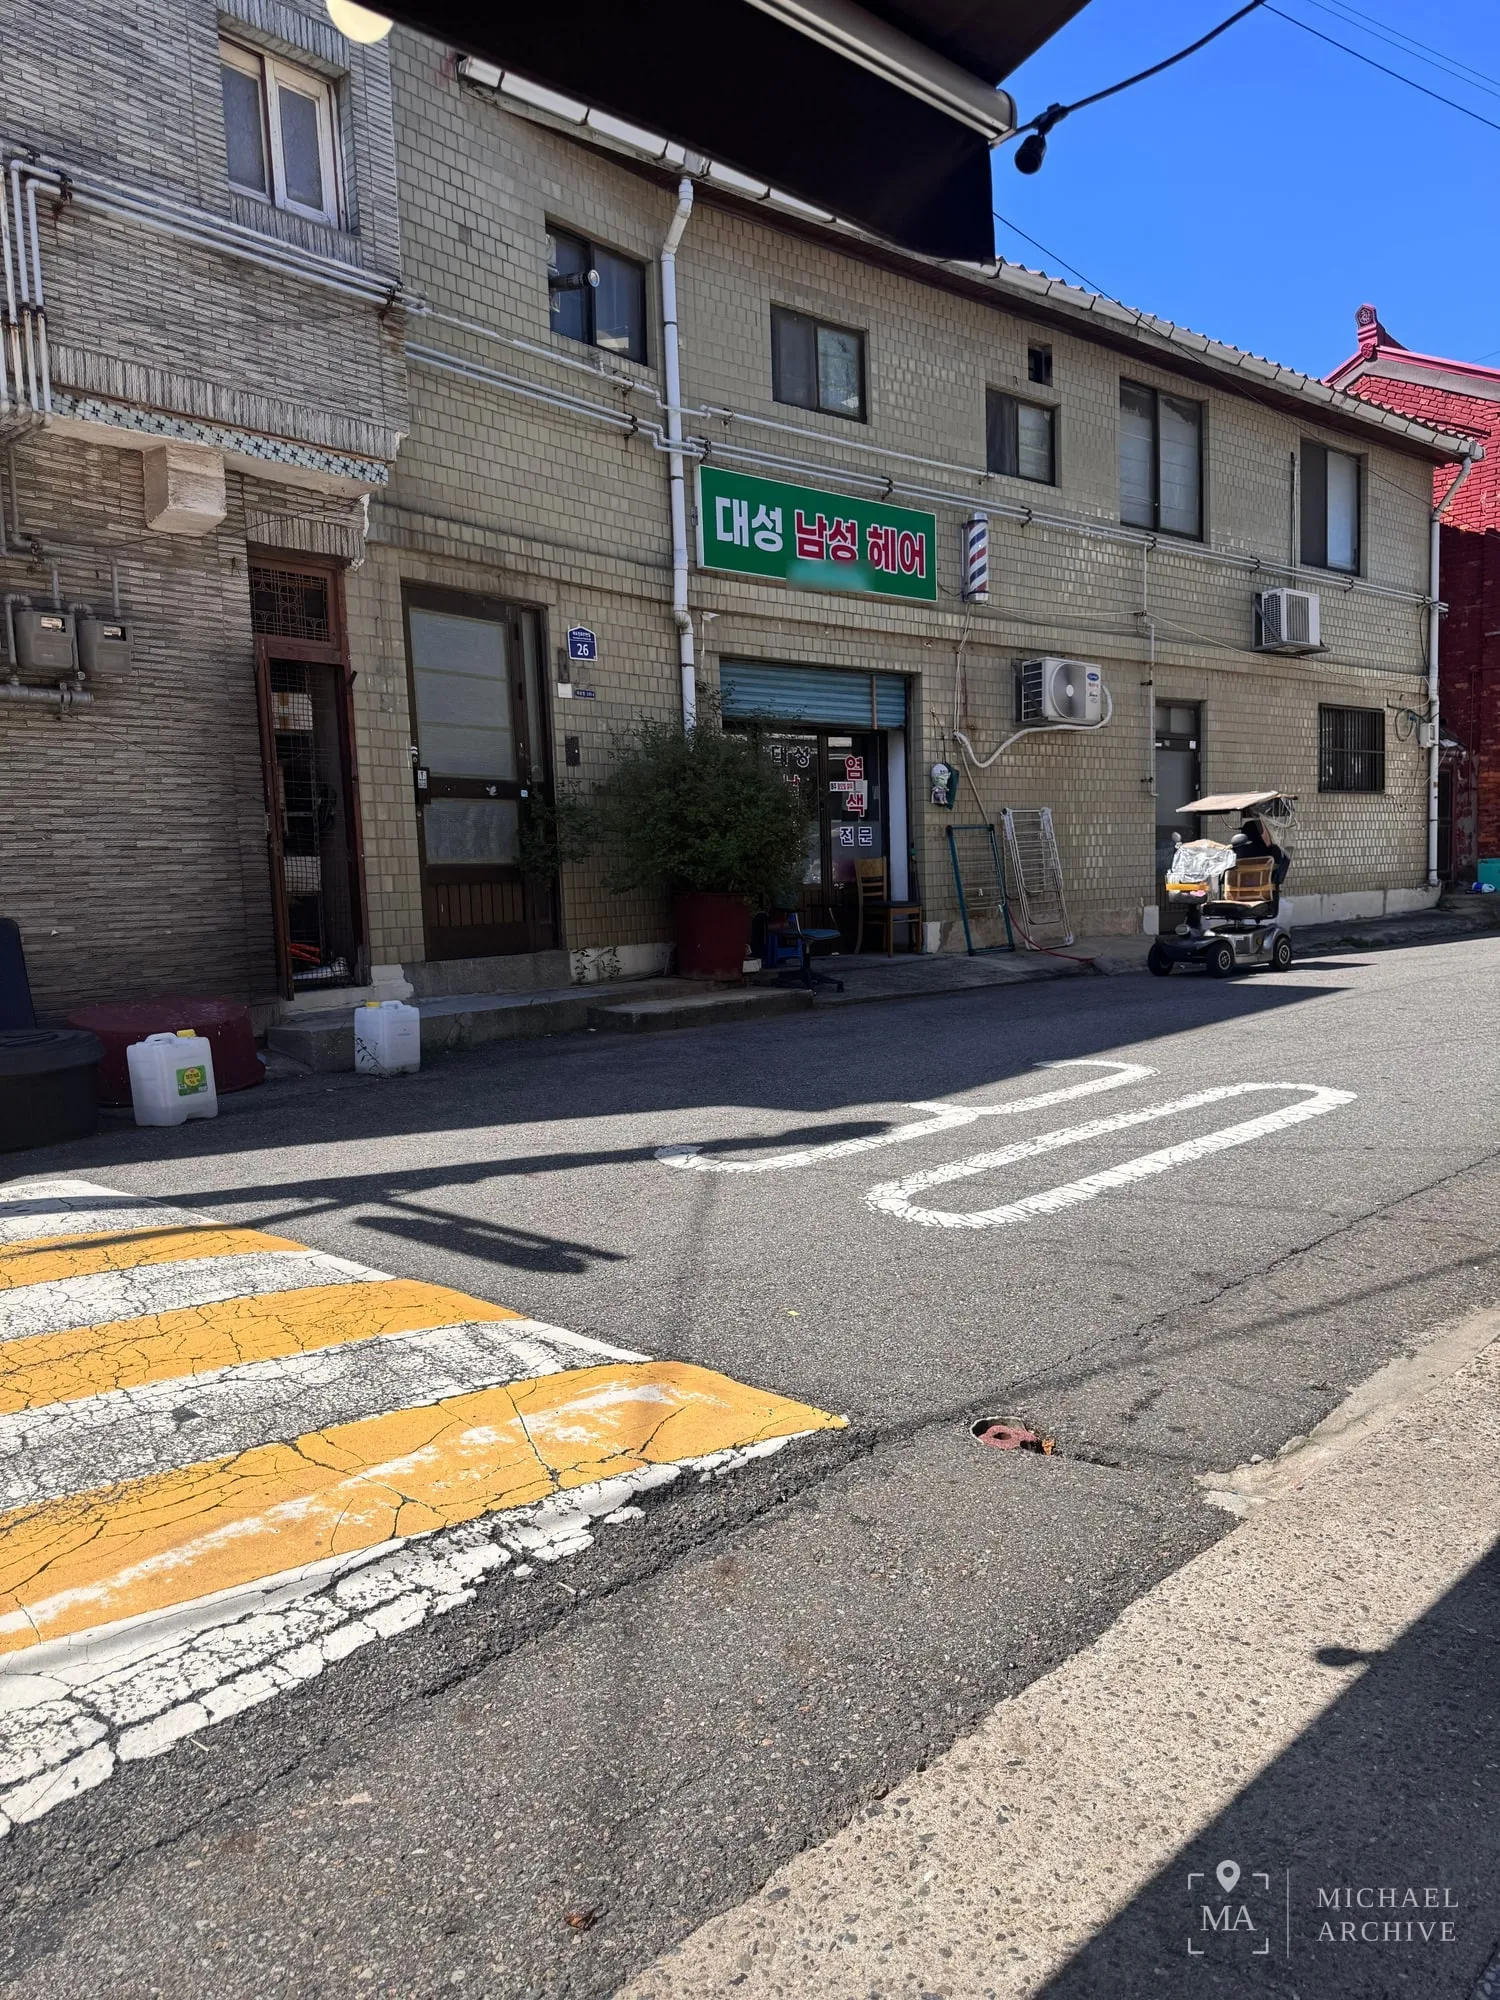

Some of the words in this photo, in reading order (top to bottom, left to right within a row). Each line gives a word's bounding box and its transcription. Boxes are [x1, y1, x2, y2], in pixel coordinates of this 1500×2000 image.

[715, 496, 783, 552] 대성
[795, 509, 858, 562] 남성
[867, 524, 926, 578] 헤어
[577, 643, 589, 656] 26
[840, 826, 872, 846] 전문
